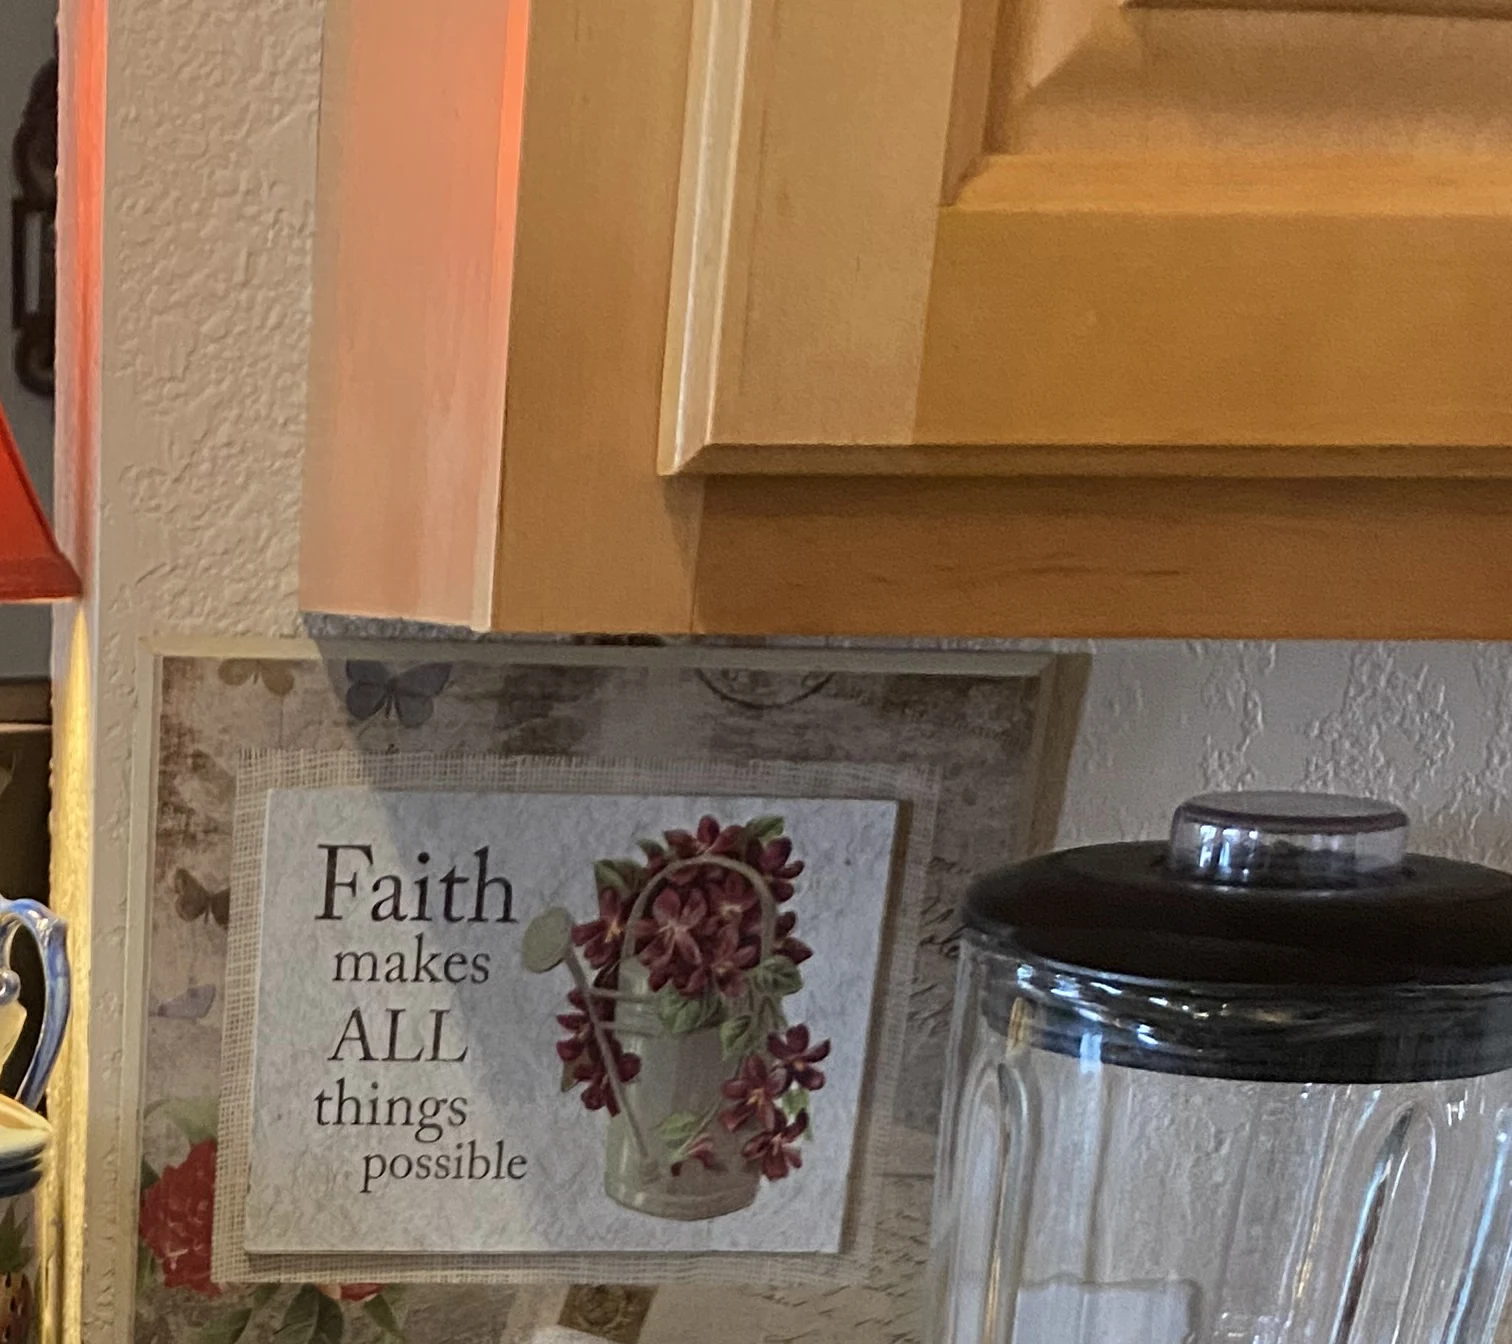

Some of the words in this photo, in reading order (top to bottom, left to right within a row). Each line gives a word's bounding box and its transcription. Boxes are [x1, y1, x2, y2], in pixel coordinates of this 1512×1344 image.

[315, 842, 519, 924] Faith
[332, 932, 492, 985] makes
[328, 1008, 469, 1063] ALL
[315, 1078, 469, 1143] things
[361, 1139, 529, 1194] possible
